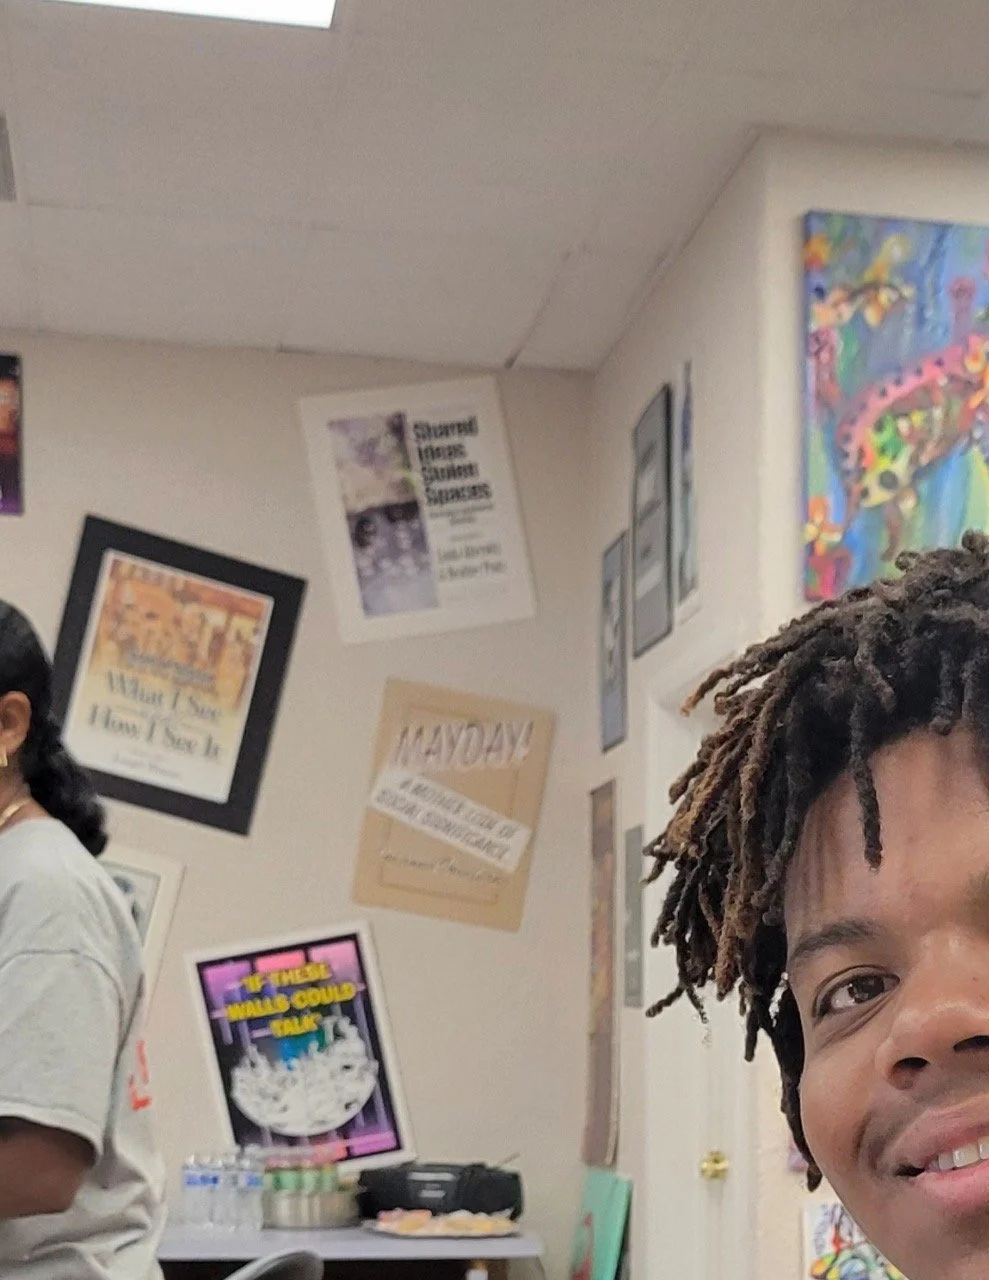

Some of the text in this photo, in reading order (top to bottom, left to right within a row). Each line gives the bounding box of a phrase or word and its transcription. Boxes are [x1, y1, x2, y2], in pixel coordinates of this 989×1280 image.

[106, 671, 165, 704] What
[186, 695, 224, 723] See
[89, 704, 140, 738] How
[163, 725, 199, 754] See
[226, 982, 356, 1023] WALLS COULD
